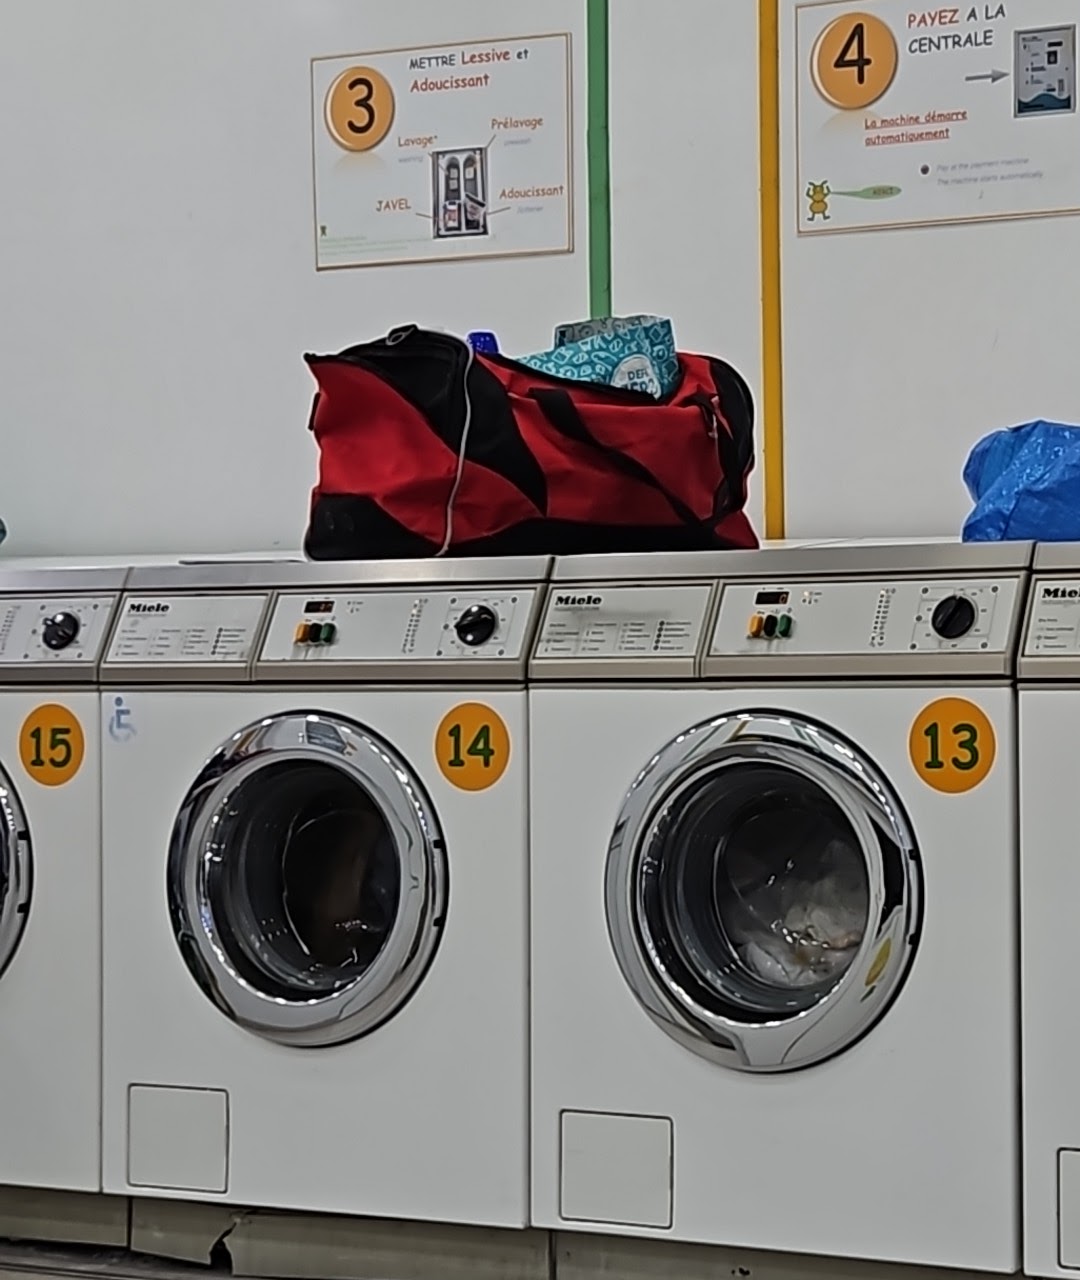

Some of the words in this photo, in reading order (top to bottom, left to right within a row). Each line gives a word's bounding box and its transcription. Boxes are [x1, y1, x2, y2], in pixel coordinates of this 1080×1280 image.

[908, 8, 960, 28] PAYEZ
[966, 7, 978, 21] A
[985, 4, 1006, 20] LA
[908, 29, 994, 55] CENTRALE
[409, 54, 456, 70] METTRE
[461, 49, 511, 65] Lessive
[516, 49, 529, 60] et
[833, 22, 872, 85] 4
[410, 73, 490, 93] Adoucissant
[347, 77, 376, 134] 3
[491, 116, 544, 131] Prélavage
[865, 118, 877, 129] La
[880, 114, 920, 127] machine
[925, 110, 968, 123] démarre
[865, 128, 950, 146] automatiquement
[499, 185, 564, 199] Adoucissant
[376, 199, 412, 212] JAVEL
[128, 603, 169, 613] Miele
[555, 595, 602, 606] Miele
[29, 726, 73, 768] 15
[447, 723, 495, 768] 14
[924, 722, 980, 770] 13
